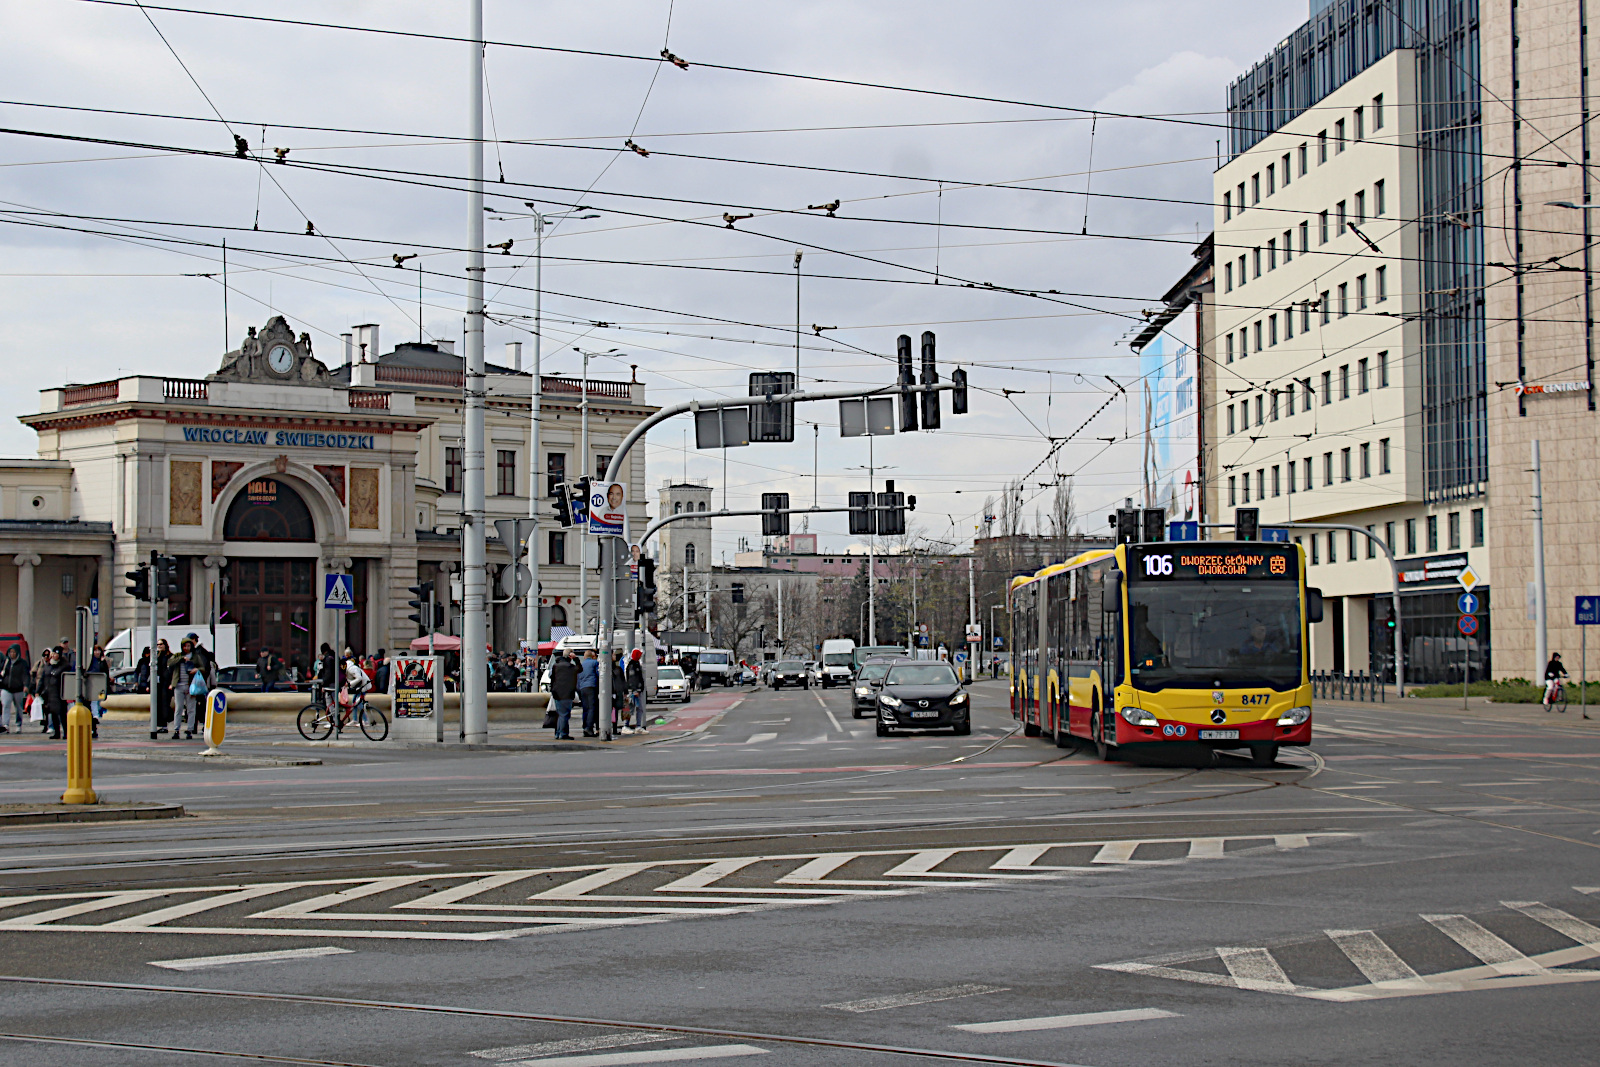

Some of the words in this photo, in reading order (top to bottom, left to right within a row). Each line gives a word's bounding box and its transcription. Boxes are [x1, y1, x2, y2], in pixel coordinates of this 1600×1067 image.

[183, 427, 268, 445] WROCŁAW
[593, 497, 602, 505] 10
[1143, 555, 1172, 575] 106
[1181, 556, 1222, 565] DWORZEC
[1225, 554, 1264, 565] GŁÓWNY
[1199, 565, 1247, 575] DWORCOWA
[1578, 613, 1594, 621] BUS
[1242, 694, 1270, 705] 8477
